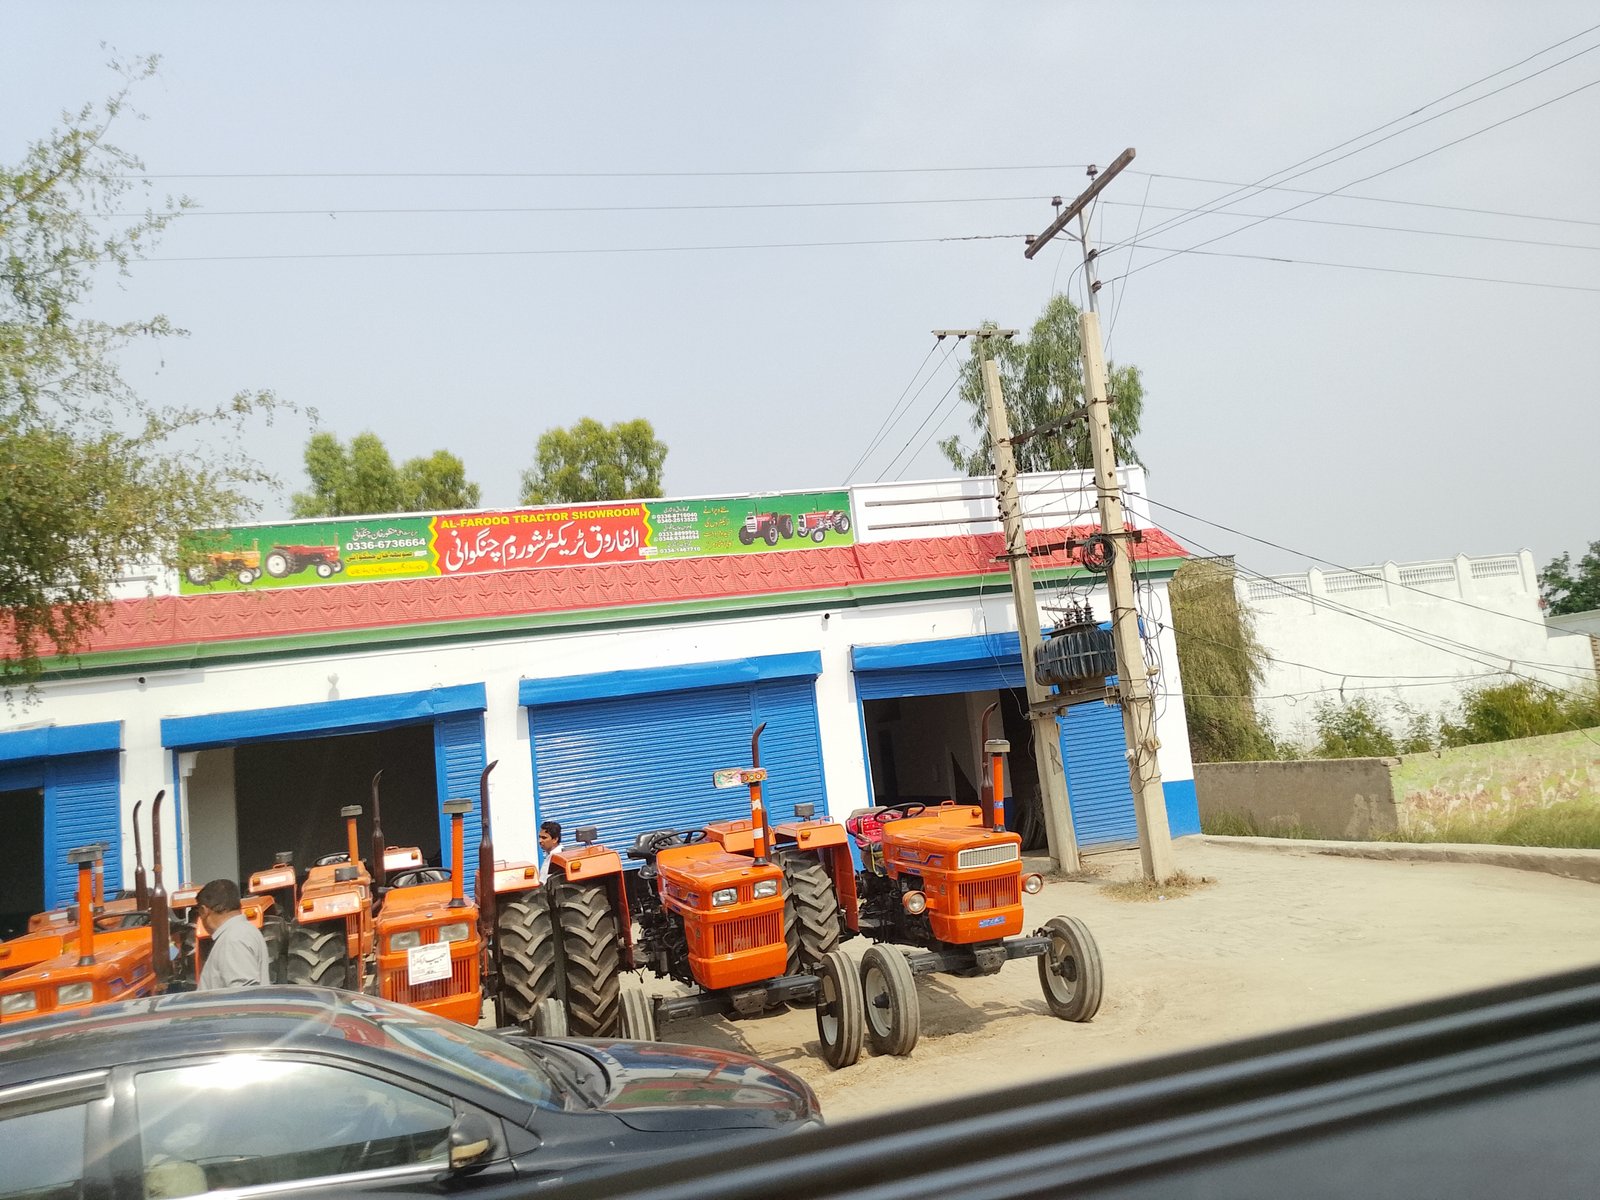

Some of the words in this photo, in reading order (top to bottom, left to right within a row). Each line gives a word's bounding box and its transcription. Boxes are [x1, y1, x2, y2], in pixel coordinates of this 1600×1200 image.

[441, 516, 510, 529] AL-FAROOQ
[513, 512, 569, 523] TRACTOR
[571, 507, 640, 520] SHOWROOM
[346, 538, 426, 550] 0336-6736664
[445, 528, 500, 570] چنگوانی
[583, 526, 639, 558] الفاروق
